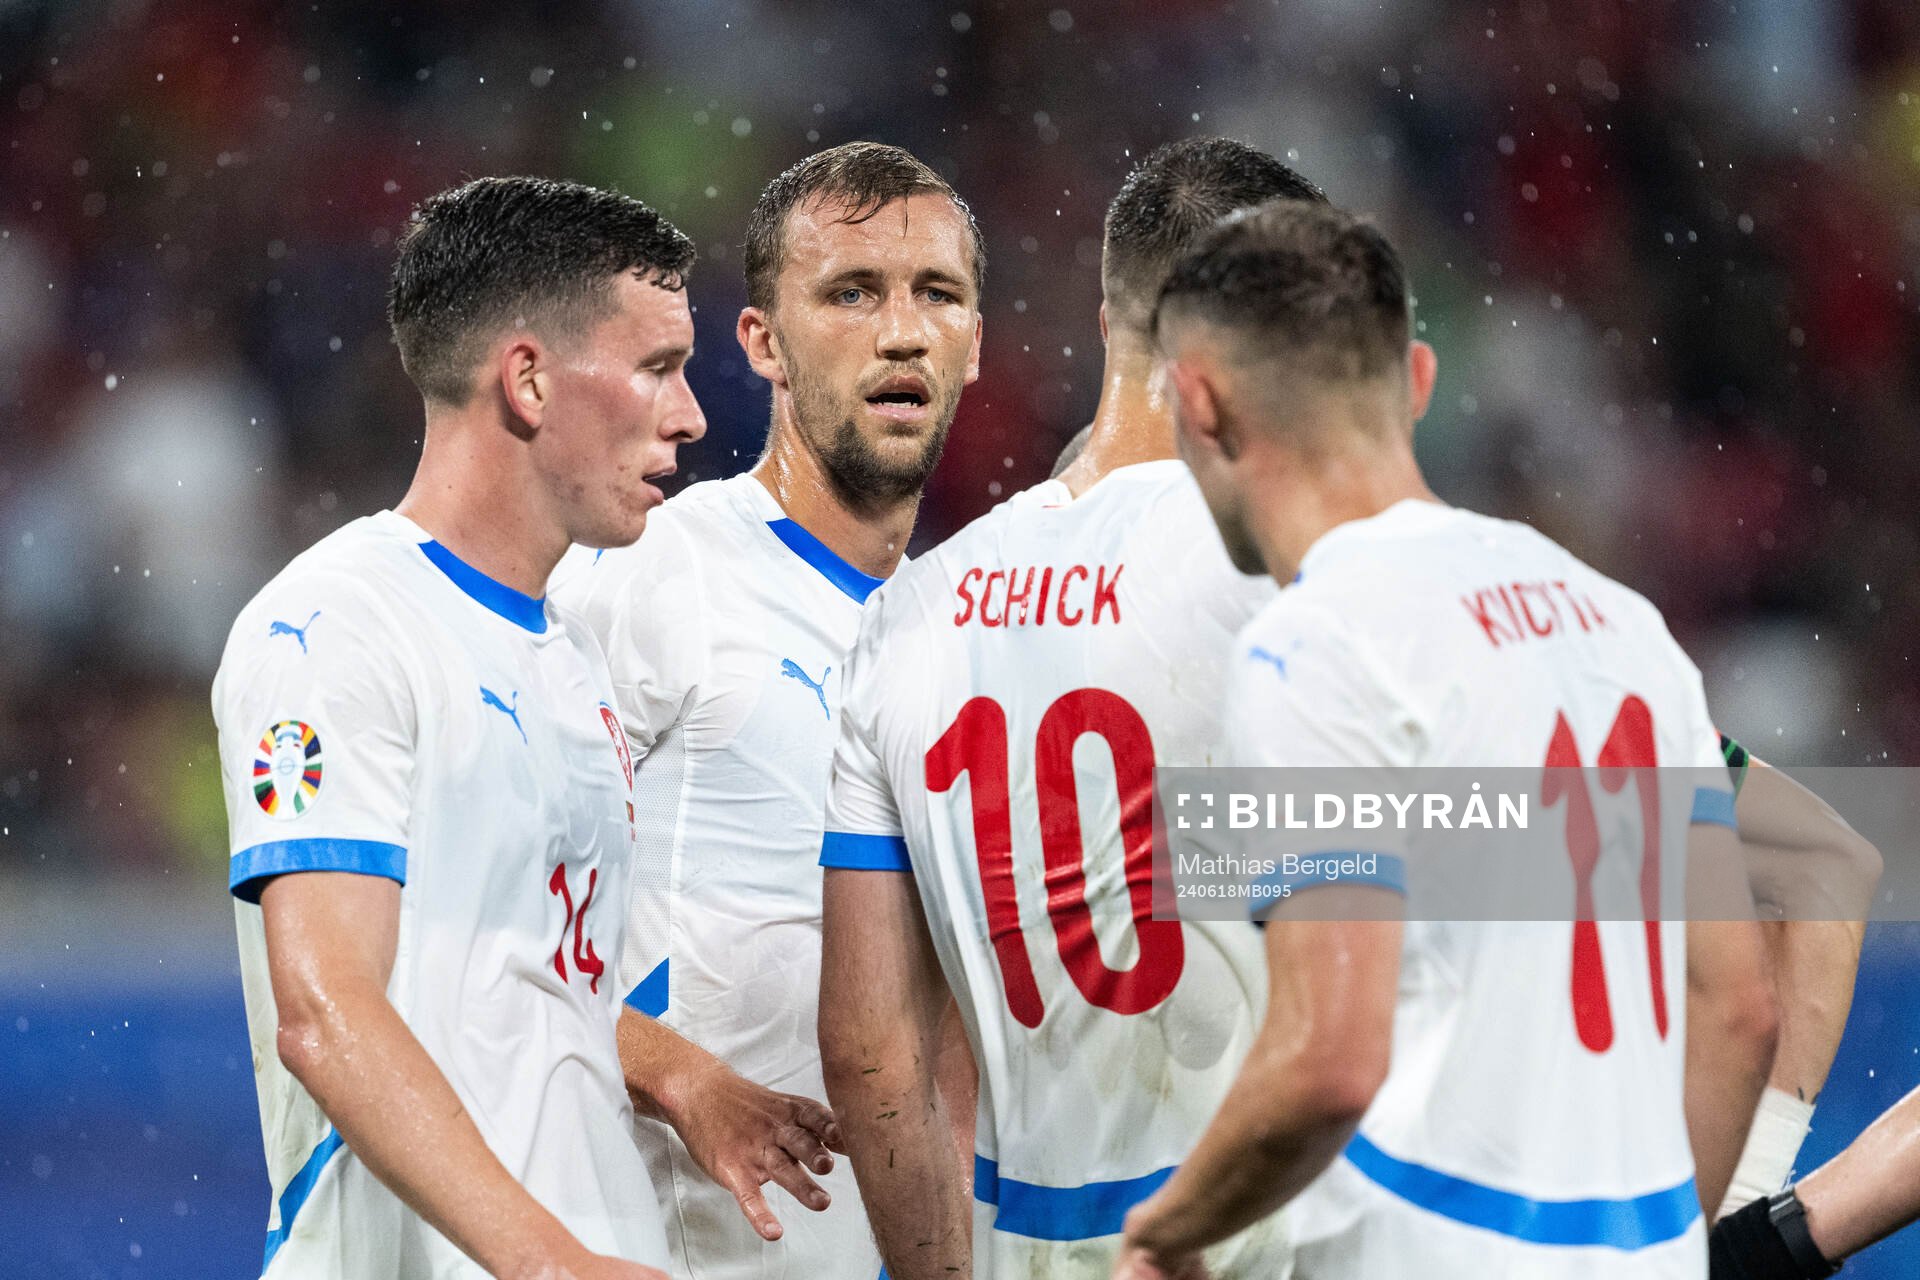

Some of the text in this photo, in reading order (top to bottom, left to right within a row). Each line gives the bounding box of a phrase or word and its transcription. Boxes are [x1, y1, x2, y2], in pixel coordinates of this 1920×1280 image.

[954, 563, 1124, 628] SCHICK
[549, 862, 604, 995] 14
[925, 687, 1185, 1029] 10
[1540, 693, 1669, 1054] 11
